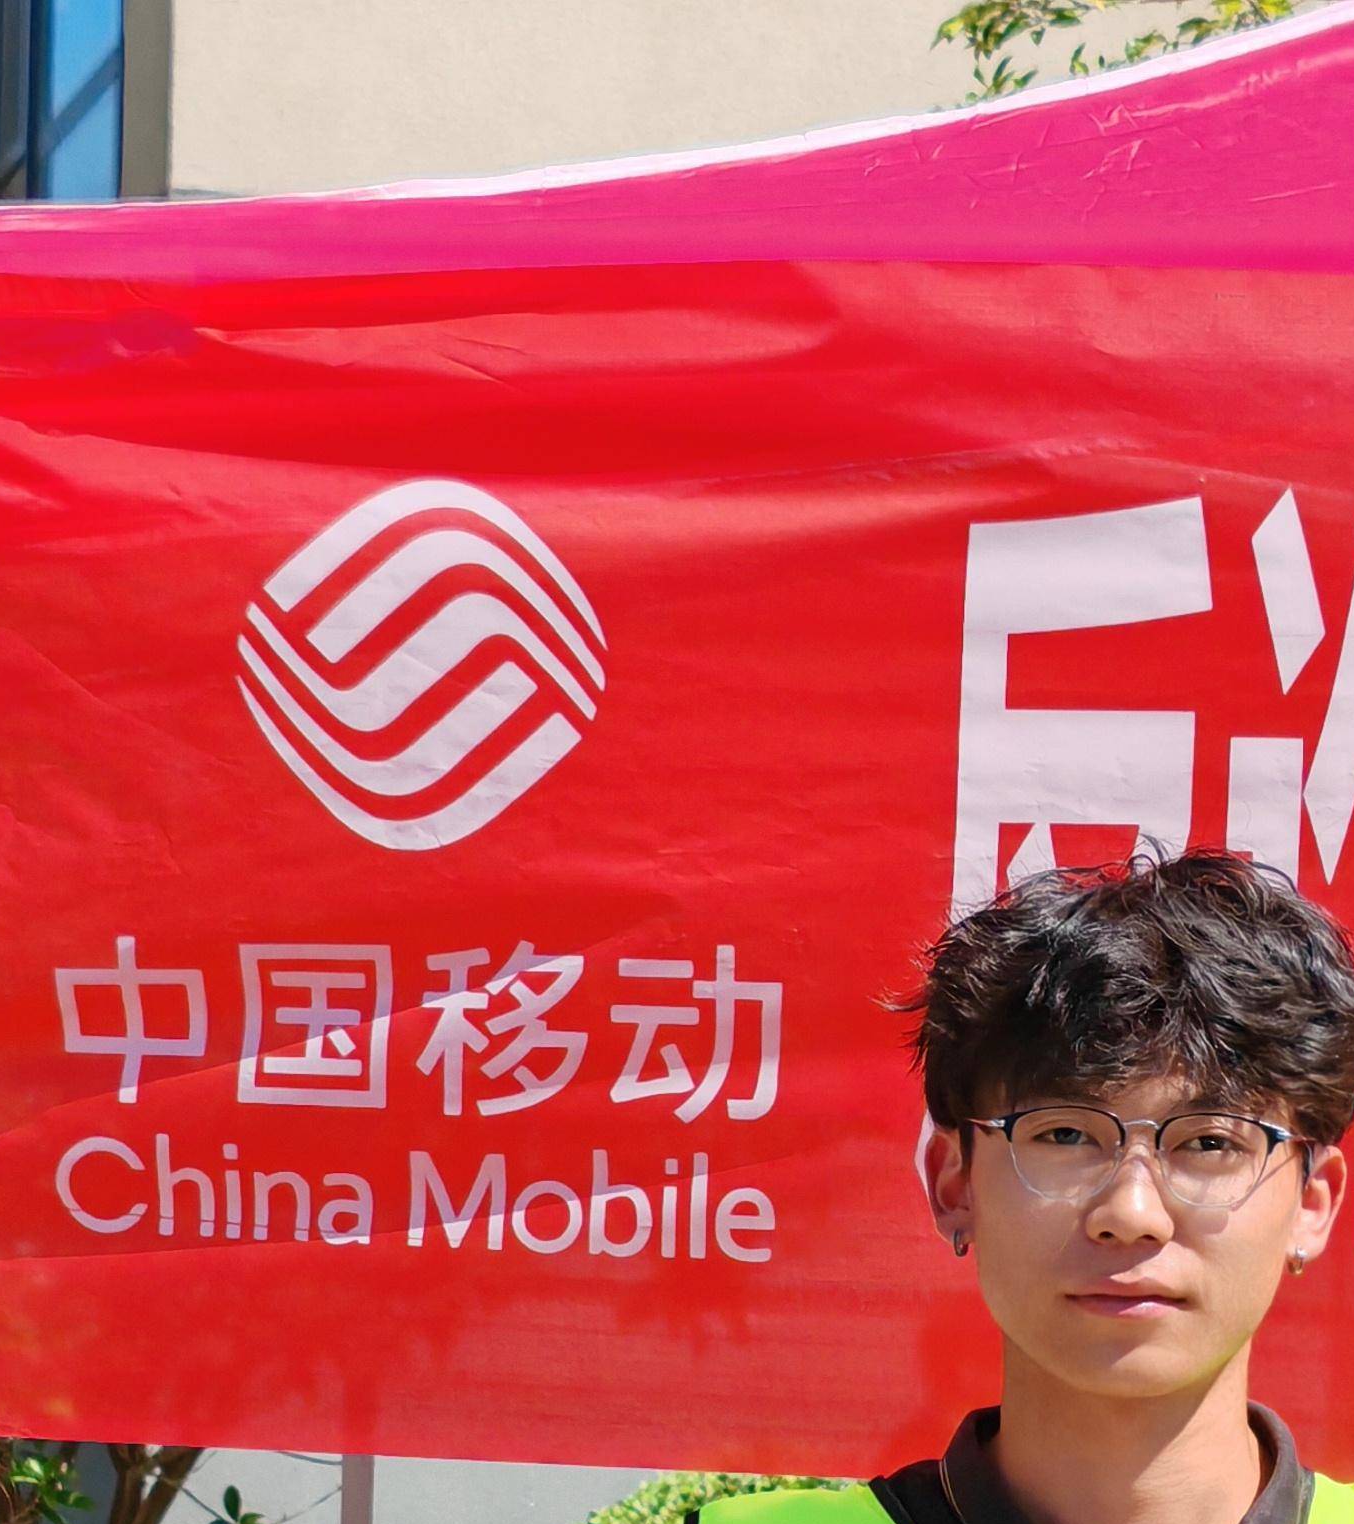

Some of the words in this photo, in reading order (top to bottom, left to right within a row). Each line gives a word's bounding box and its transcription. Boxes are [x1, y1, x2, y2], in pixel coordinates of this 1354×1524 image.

[54, 935, 783, 1123] 中国移动
[55, 1132, 374, 1247] China
[406, 1148, 776, 1263] Mobile
